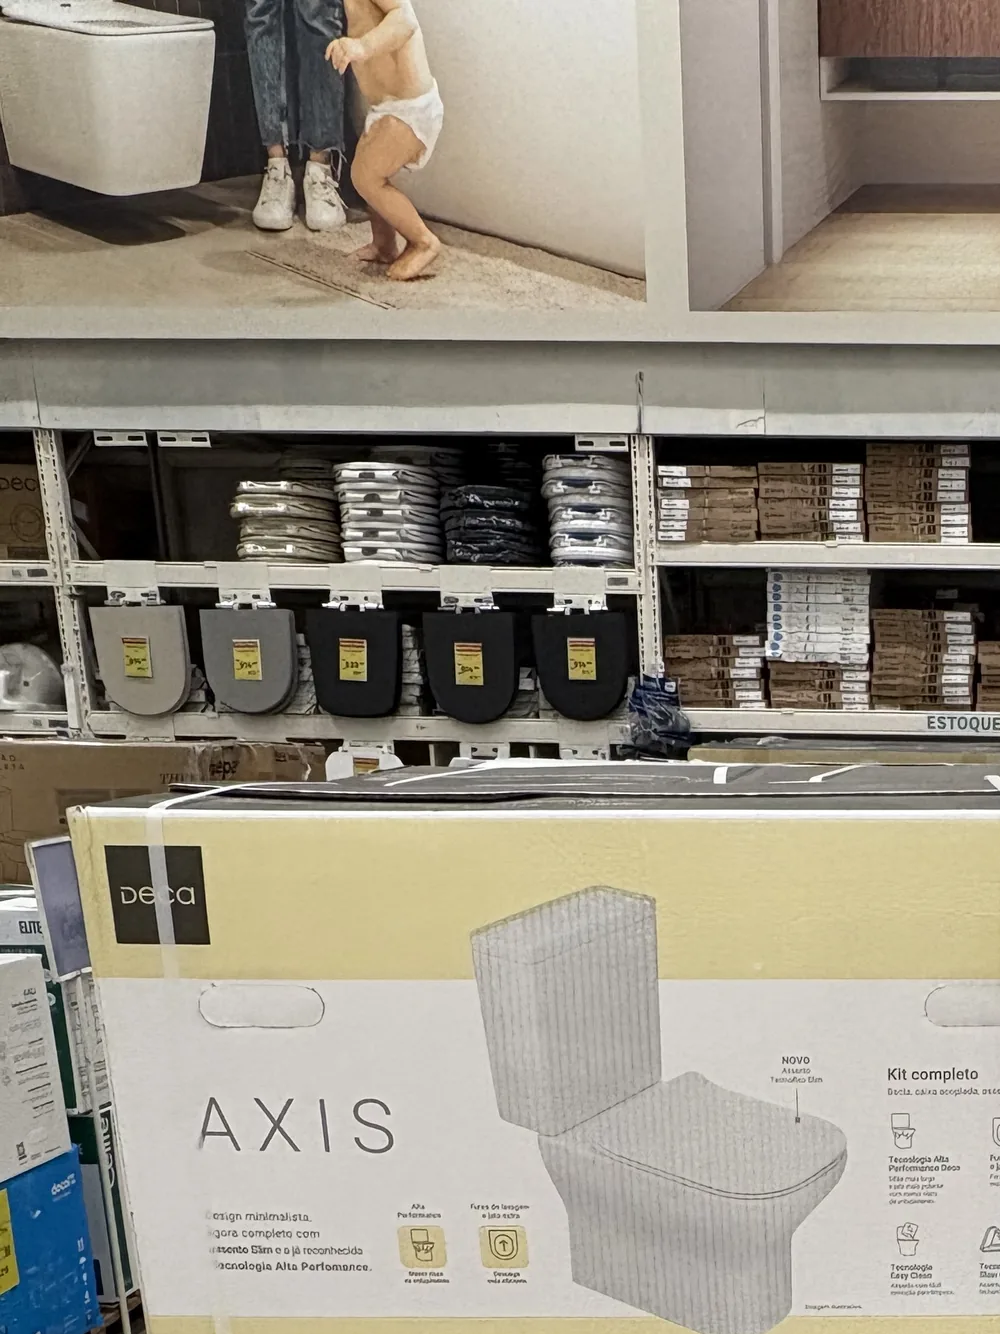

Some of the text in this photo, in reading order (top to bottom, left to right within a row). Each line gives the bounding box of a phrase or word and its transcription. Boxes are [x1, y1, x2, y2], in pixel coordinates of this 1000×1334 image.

[0, 476, 39, 491] Dec
[781, 1056, 810, 1065] NOVO
[887, 1067, 979, 1083] Kit completo
[198, 1097, 395, 1154] AXIS
[296, 1230, 320, 1239] com
